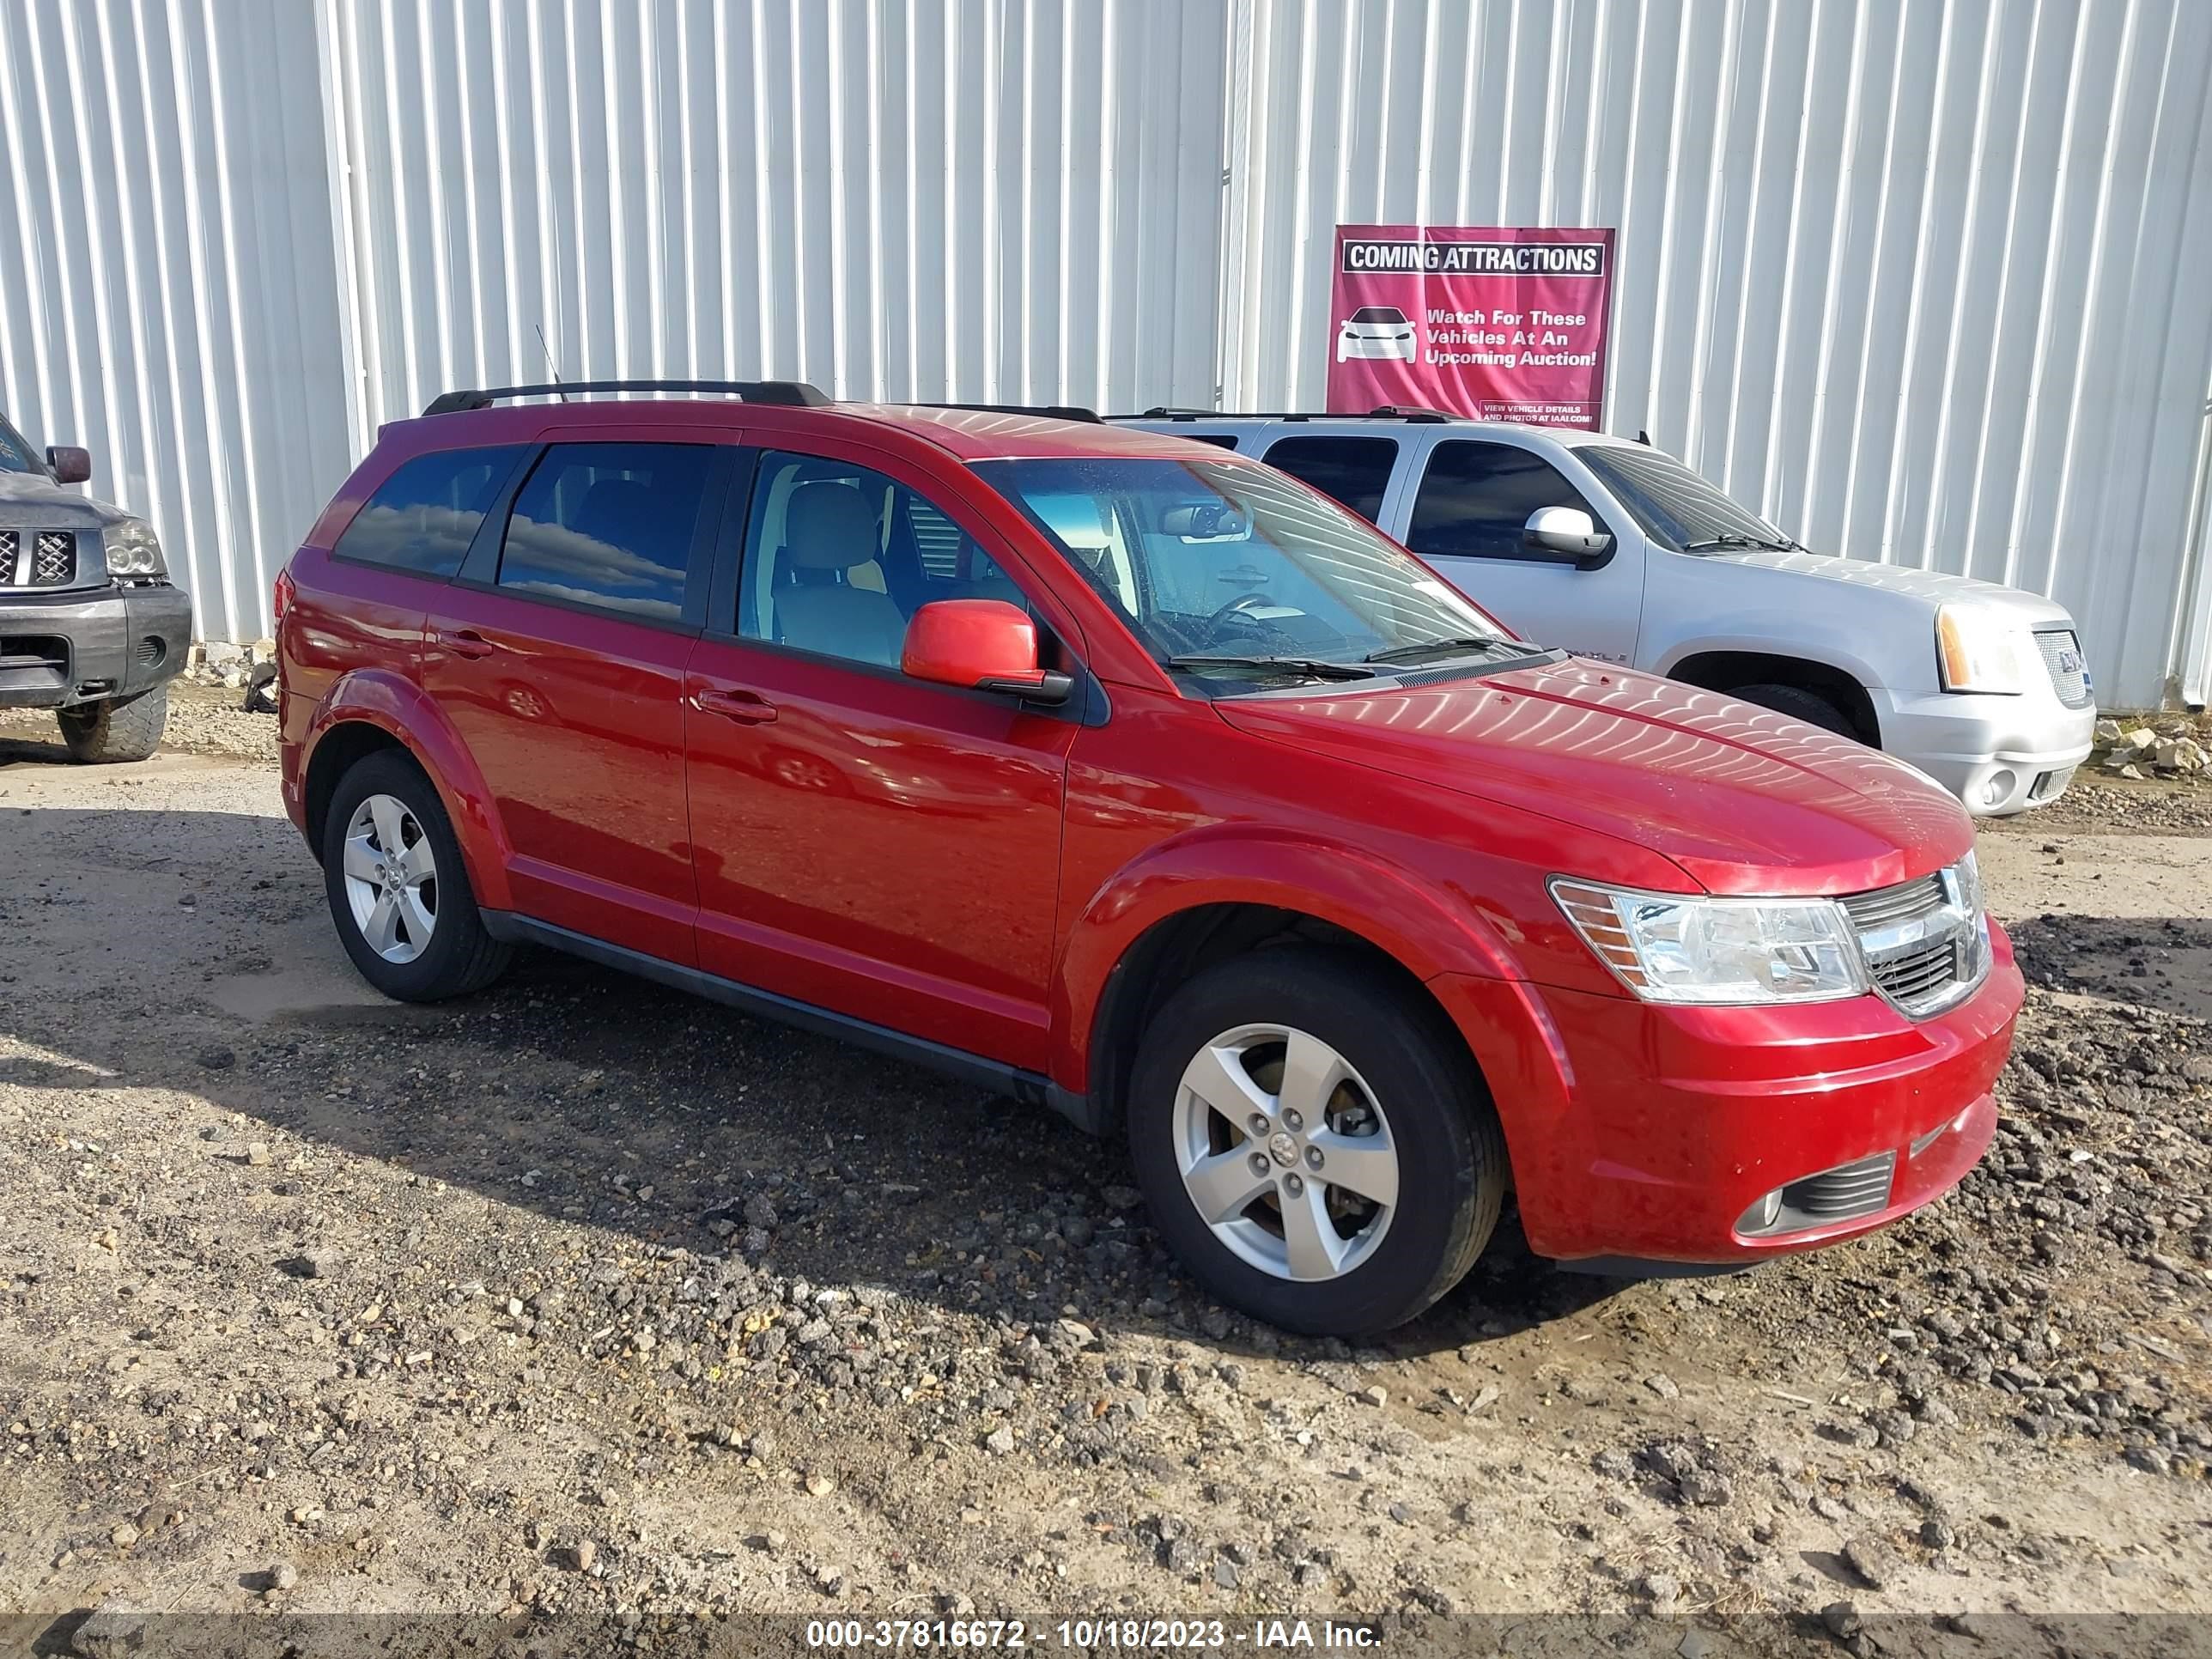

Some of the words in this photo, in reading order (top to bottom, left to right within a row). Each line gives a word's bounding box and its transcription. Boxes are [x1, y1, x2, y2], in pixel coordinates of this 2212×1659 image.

[1350, 245, 1438, 269] COMING
[1443, 246, 1597, 271] ATTRACTIONS
[1426, 309, 1486, 325] Watch
[1492, 310, 1523, 325] For
[1529, 310, 1586, 326] These
[1425, 329, 1506, 345] Vehicles
[1510, 330, 1535, 345] At
[1540, 331, 1569, 346] An
[1424, 349, 1516, 368] Upcoming
[1518, 350, 1597, 367] Auction!
[1545, 405, 1581, 414] DETAILS
